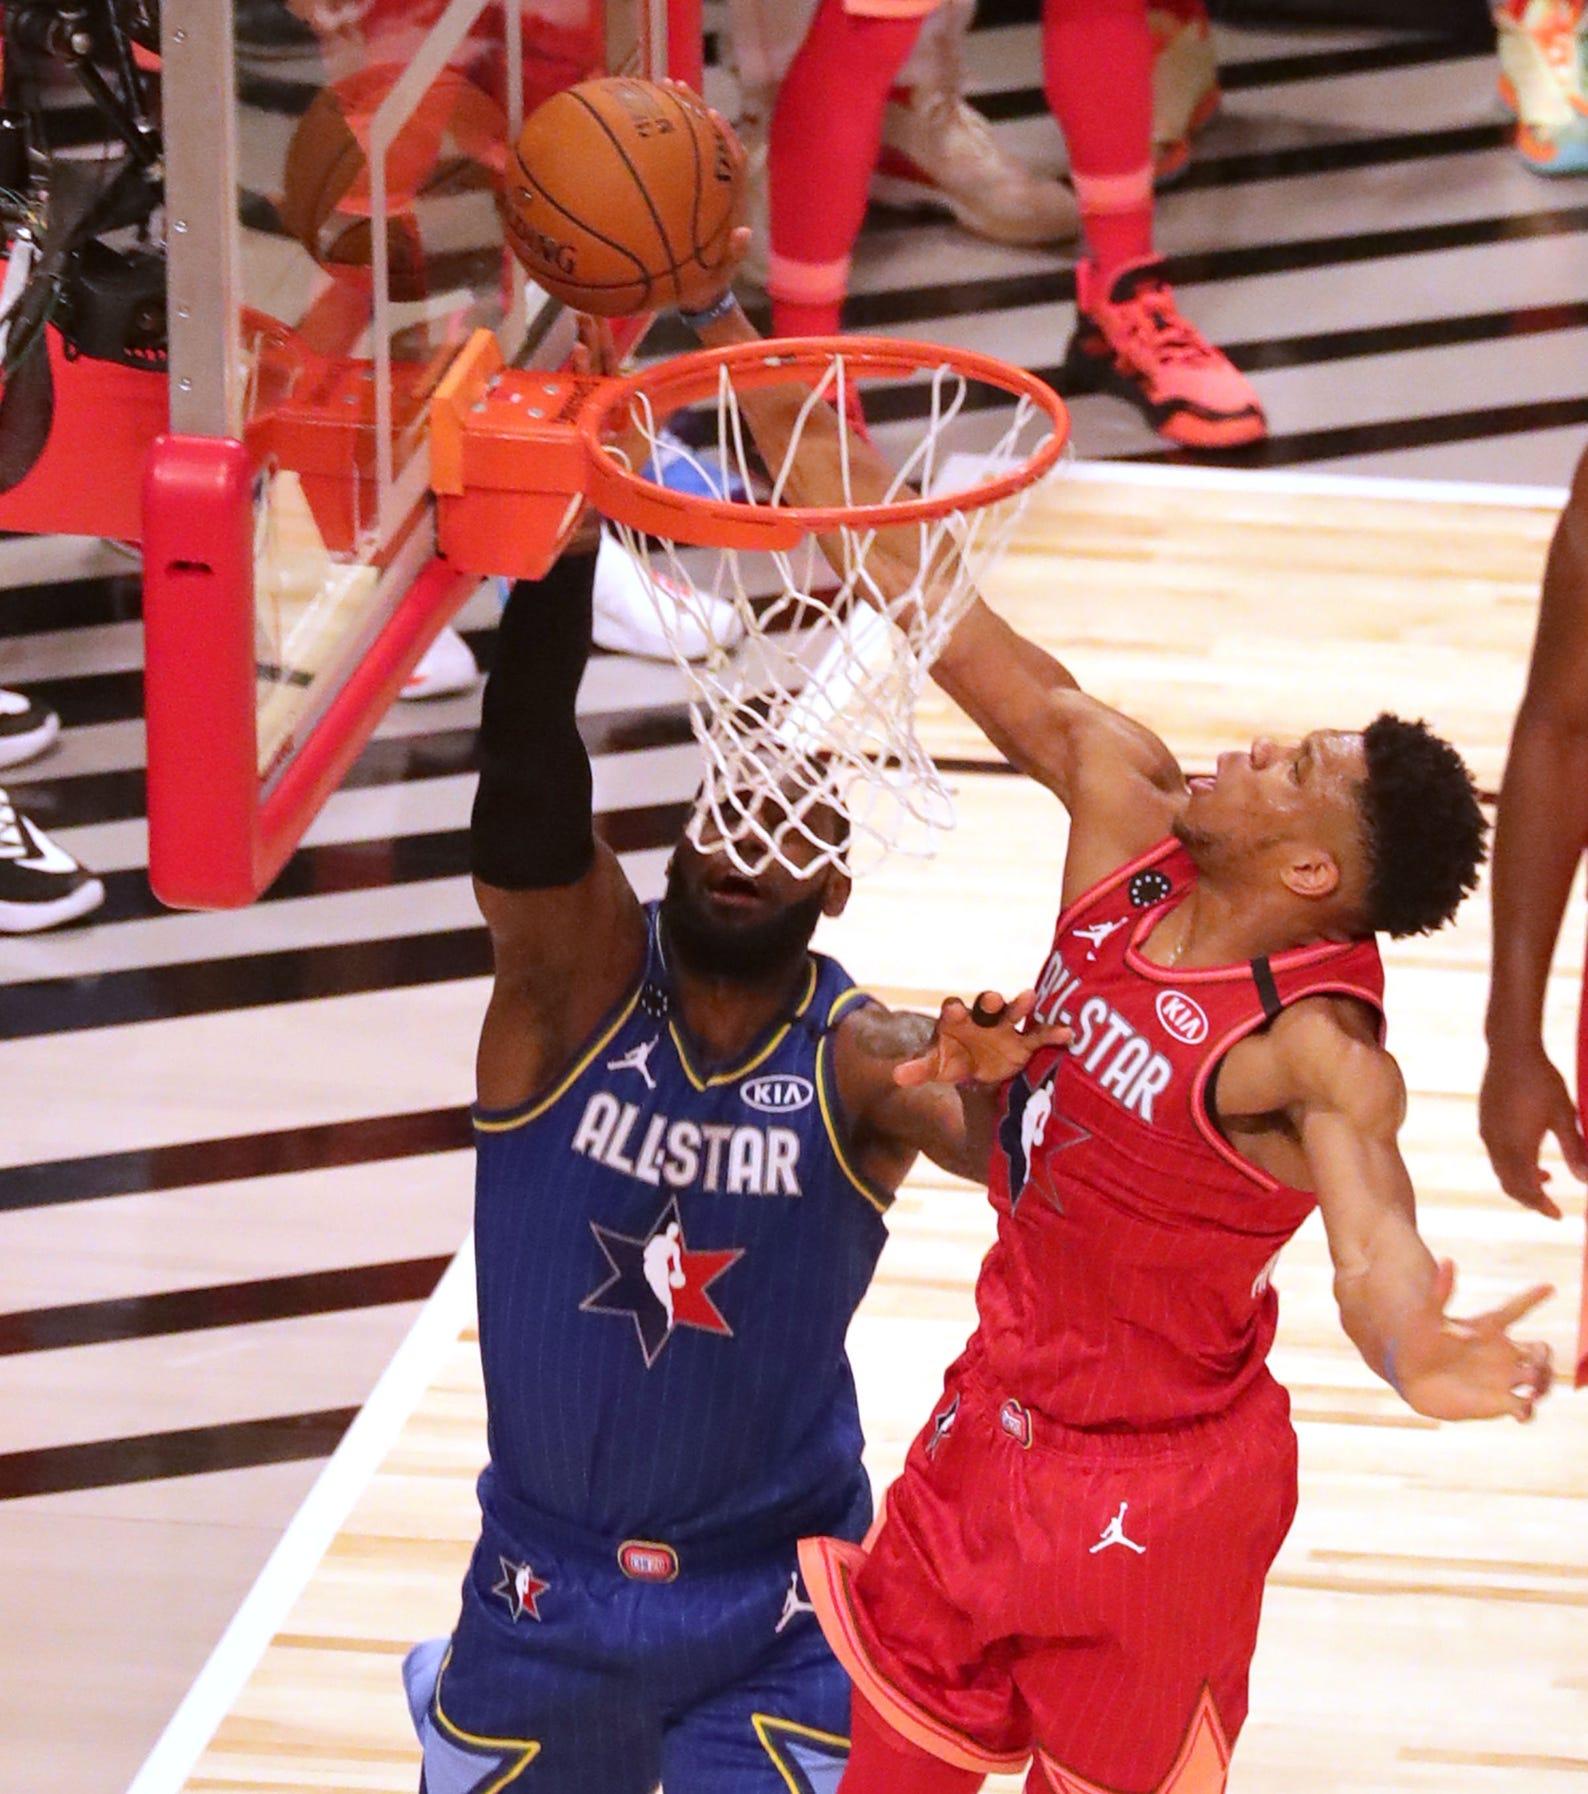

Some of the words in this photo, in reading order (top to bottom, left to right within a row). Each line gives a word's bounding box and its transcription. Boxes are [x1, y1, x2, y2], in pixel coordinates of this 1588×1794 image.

[1033, 950, 1173, 1124] ALL-STAR
[1163, 996, 1201, 1039] KIA
[571, 1091, 802, 1197] ALL-STAR
